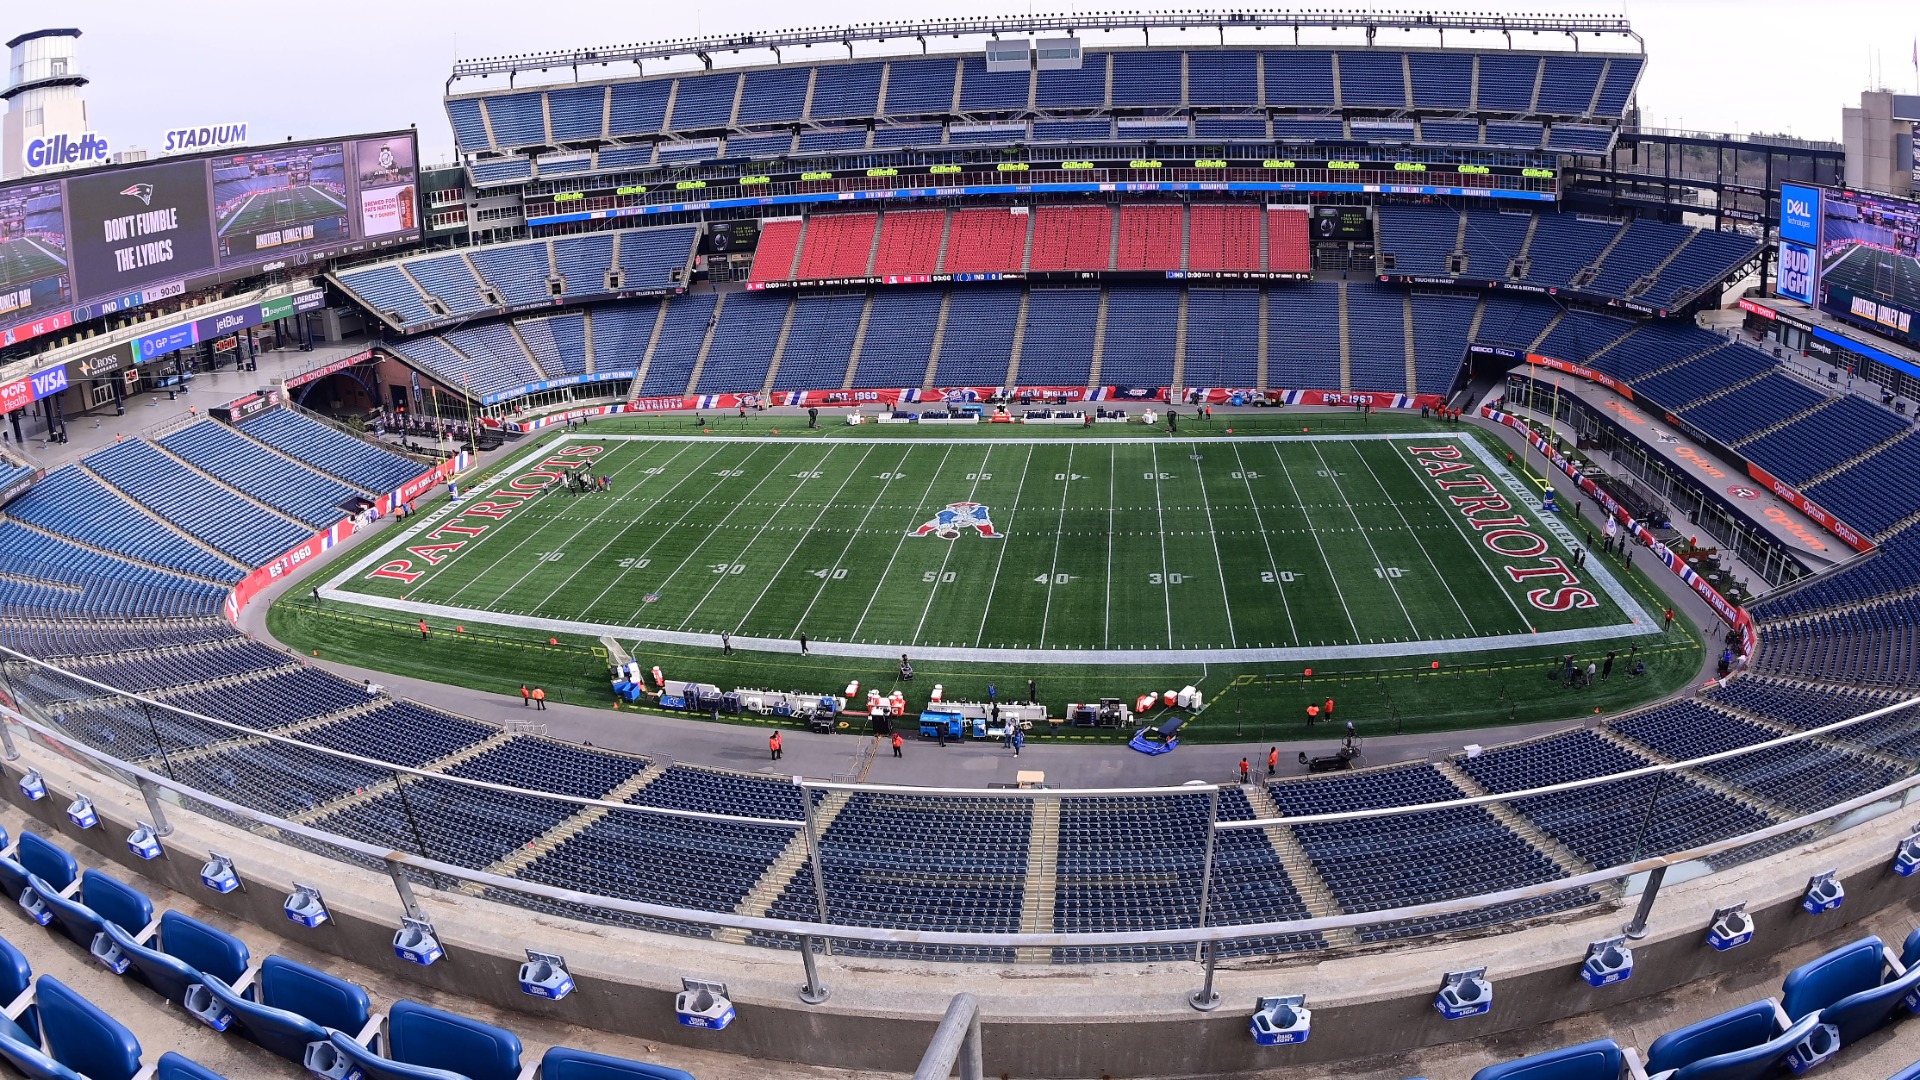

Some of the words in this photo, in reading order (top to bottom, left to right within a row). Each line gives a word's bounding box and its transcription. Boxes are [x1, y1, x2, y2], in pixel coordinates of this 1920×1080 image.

[165, 124, 247, 150] STADIUM
[27, 133, 108, 168] Gillette
[930, 165, 961, 174] Gillette
[997, 163, 1029, 171] Gillette
[1062, 161, 1094, 170] Gillette
[1130, 160, 1162, 169] Gillette
[1195, 160, 1227, 168] Gillette
[1263, 160, 1295, 168] Gillette
[1328, 161, 1360, 169] Gillette
[1394, 162, 1426, 172] Gillette
[1458, 164, 1489, 175] Gillette
[801, 172, 832, 181] Gillette
[867, 168, 898, 177] Gillette
[1522, 168, 1553, 179] Gillette
[676, 180, 706, 190] Gillette
[740, 176, 770, 185] Gillette
[617, 185, 646, 195] Gillette
[554, 191, 584, 202] Gillette
[1787, 199, 1811, 218] DELL
[104, 215, 135, 242] DON'T
[137, 208, 178, 234] FUMBLE
[1787, 216, 1811, 229] Technologies
[256, 231, 281, 248] ANOTHER
[303, 224, 314, 239] DAY
[115, 249, 136, 272] THE
[136, 239, 174, 268] LYRICS
[1784, 249, 1809, 273] BUD
[263, 261, 285, 271] Gillette
[1781, 270, 1811, 296] LIGHT
[161, 284, 181, 297] 90:00
[19, 289, 31, 308] DAY
[124, 298, 130, 307] 0
[102, 301, 117, 314] IND
[1740, 300, 1755, 311] TOYOTA
[1757, 307, 1774, 317] TOYOTA
[1851, 296, 1876, 318] ANOTHER
[1898, 311, 1911, 331] DAY
[32, 322, 44, 335] NE
[53, 318, 59, 328] 0
[216, 315, 244, 333] jetBlue
[1542, 357, 1563, 369] Optum
[286, 377, 304, 388] OYOTA
[306, 368, 327, 380] TOYOTA
[329, 360, 350, 372] TOYOTA
[351, 352, 371, 364] TOYOTA
[600, 372, 612, 380] EASY
[1572, 364, 1591, 378] Optum
[32, 370, 67, 395] VISA
[546, 380, 559, 388] EASY
[1599, 374, 1615, 389] Optum
[9, 381, 26, 397] CVS
[498, 392, 508, 400] EASY
[855, 391, 878, 400] 1960
[4, 395, 29, 411] Health
[633, 398, 684, 411] PATRIOTS
[1675, 447, 1727, 478] Optum
[720, 469, 745, 477] 20
[880, 472, 906, 480] 40
[1144, 472, 1171, 480] 30
[1231, 471, 1258, 479] 20
[1774, 481, 1794, 502] Optum
[365, 444, 604, 584] PATRIOTS
[419, 500, 459, 529] TAKES
[1803, 501, 1826, 522] Optum
[1511, 484, 1540, 509] CAUSE
[1547, 522, 1584, 554] CLEATS
[1407, 445, 1600, 612] PATRIOTS
[1763, 508, 1825, 550] Optum
[1834, 521, 1858, 545] Optum
[290, 545, 312, 566] 1960
[542, 553, 565, 561] 10
[619, 558, 651, 569] 20
[712, 564, 745, 575] 30
[814, 568, 848, 580] 40
[922, 572, 957, 583] 50
[1033, 573, 1069, 585] 40
[1149, 573, 1183, 585] 30
[1260, 571, 1295, 583] 20
[1374, 567, 1402, 579] 10
[1698, 582, 1711, 598] NEW
